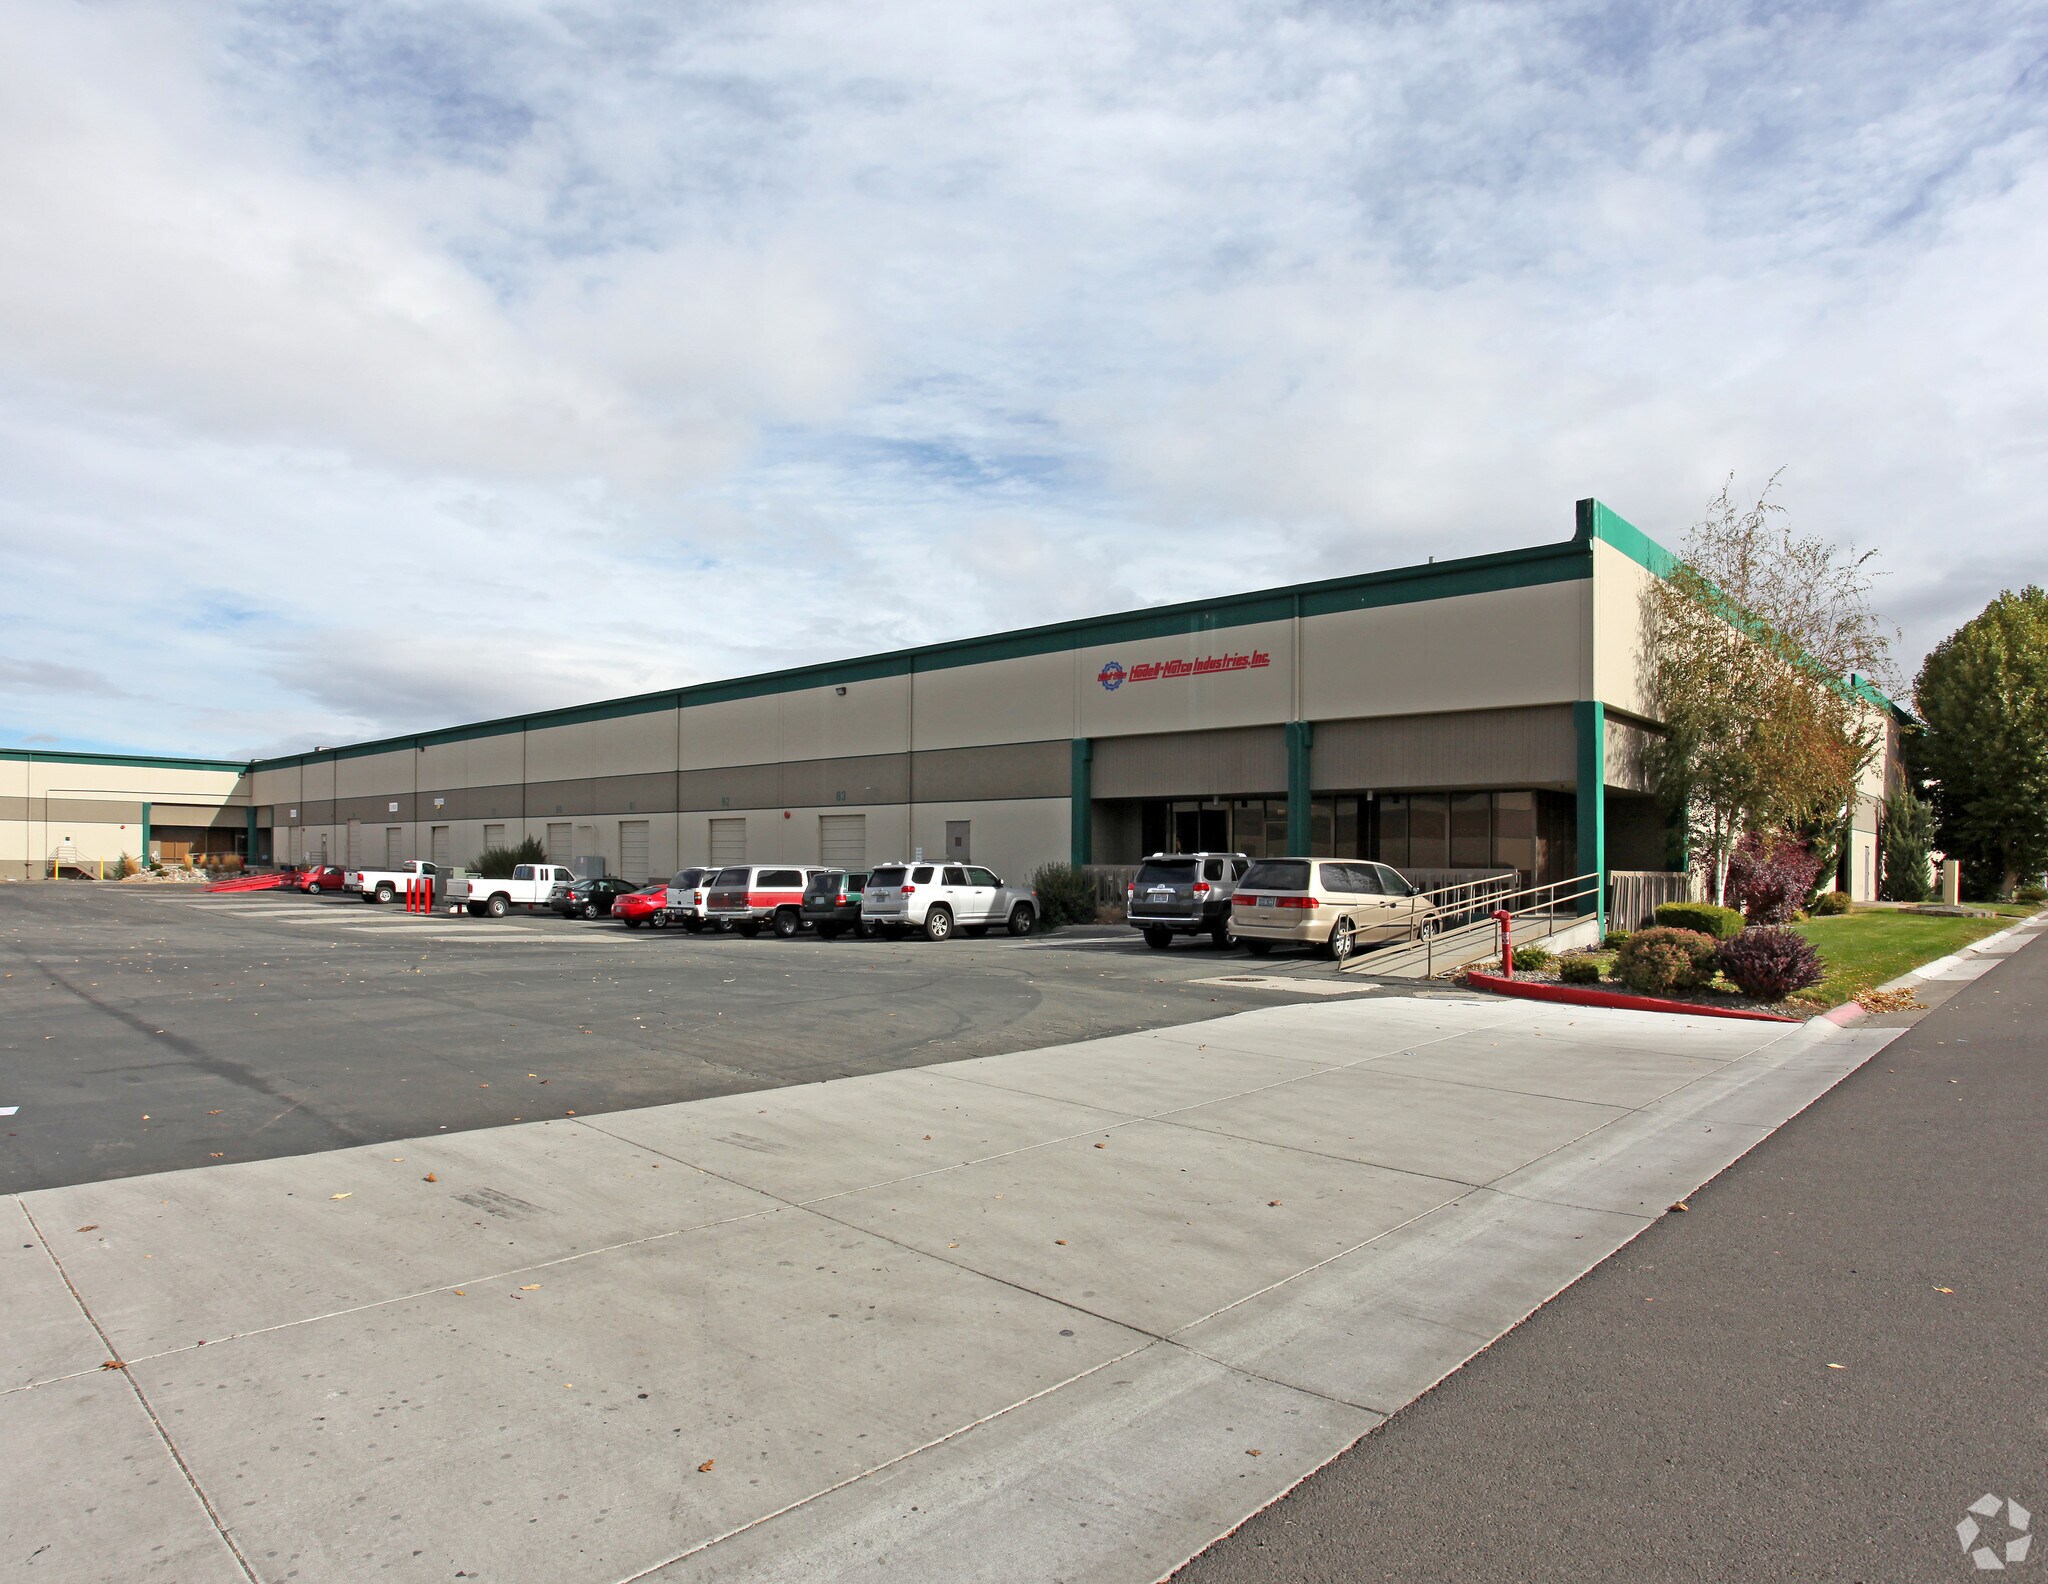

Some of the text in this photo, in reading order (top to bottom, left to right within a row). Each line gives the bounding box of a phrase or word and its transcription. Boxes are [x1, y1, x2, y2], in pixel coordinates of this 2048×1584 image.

[1193, 652, 1251, 675] Industries,
[1250, 650, 1271, 668] Inc.
[836, 791, 846, 801] 83
[722, 797, 730, 806] 82
